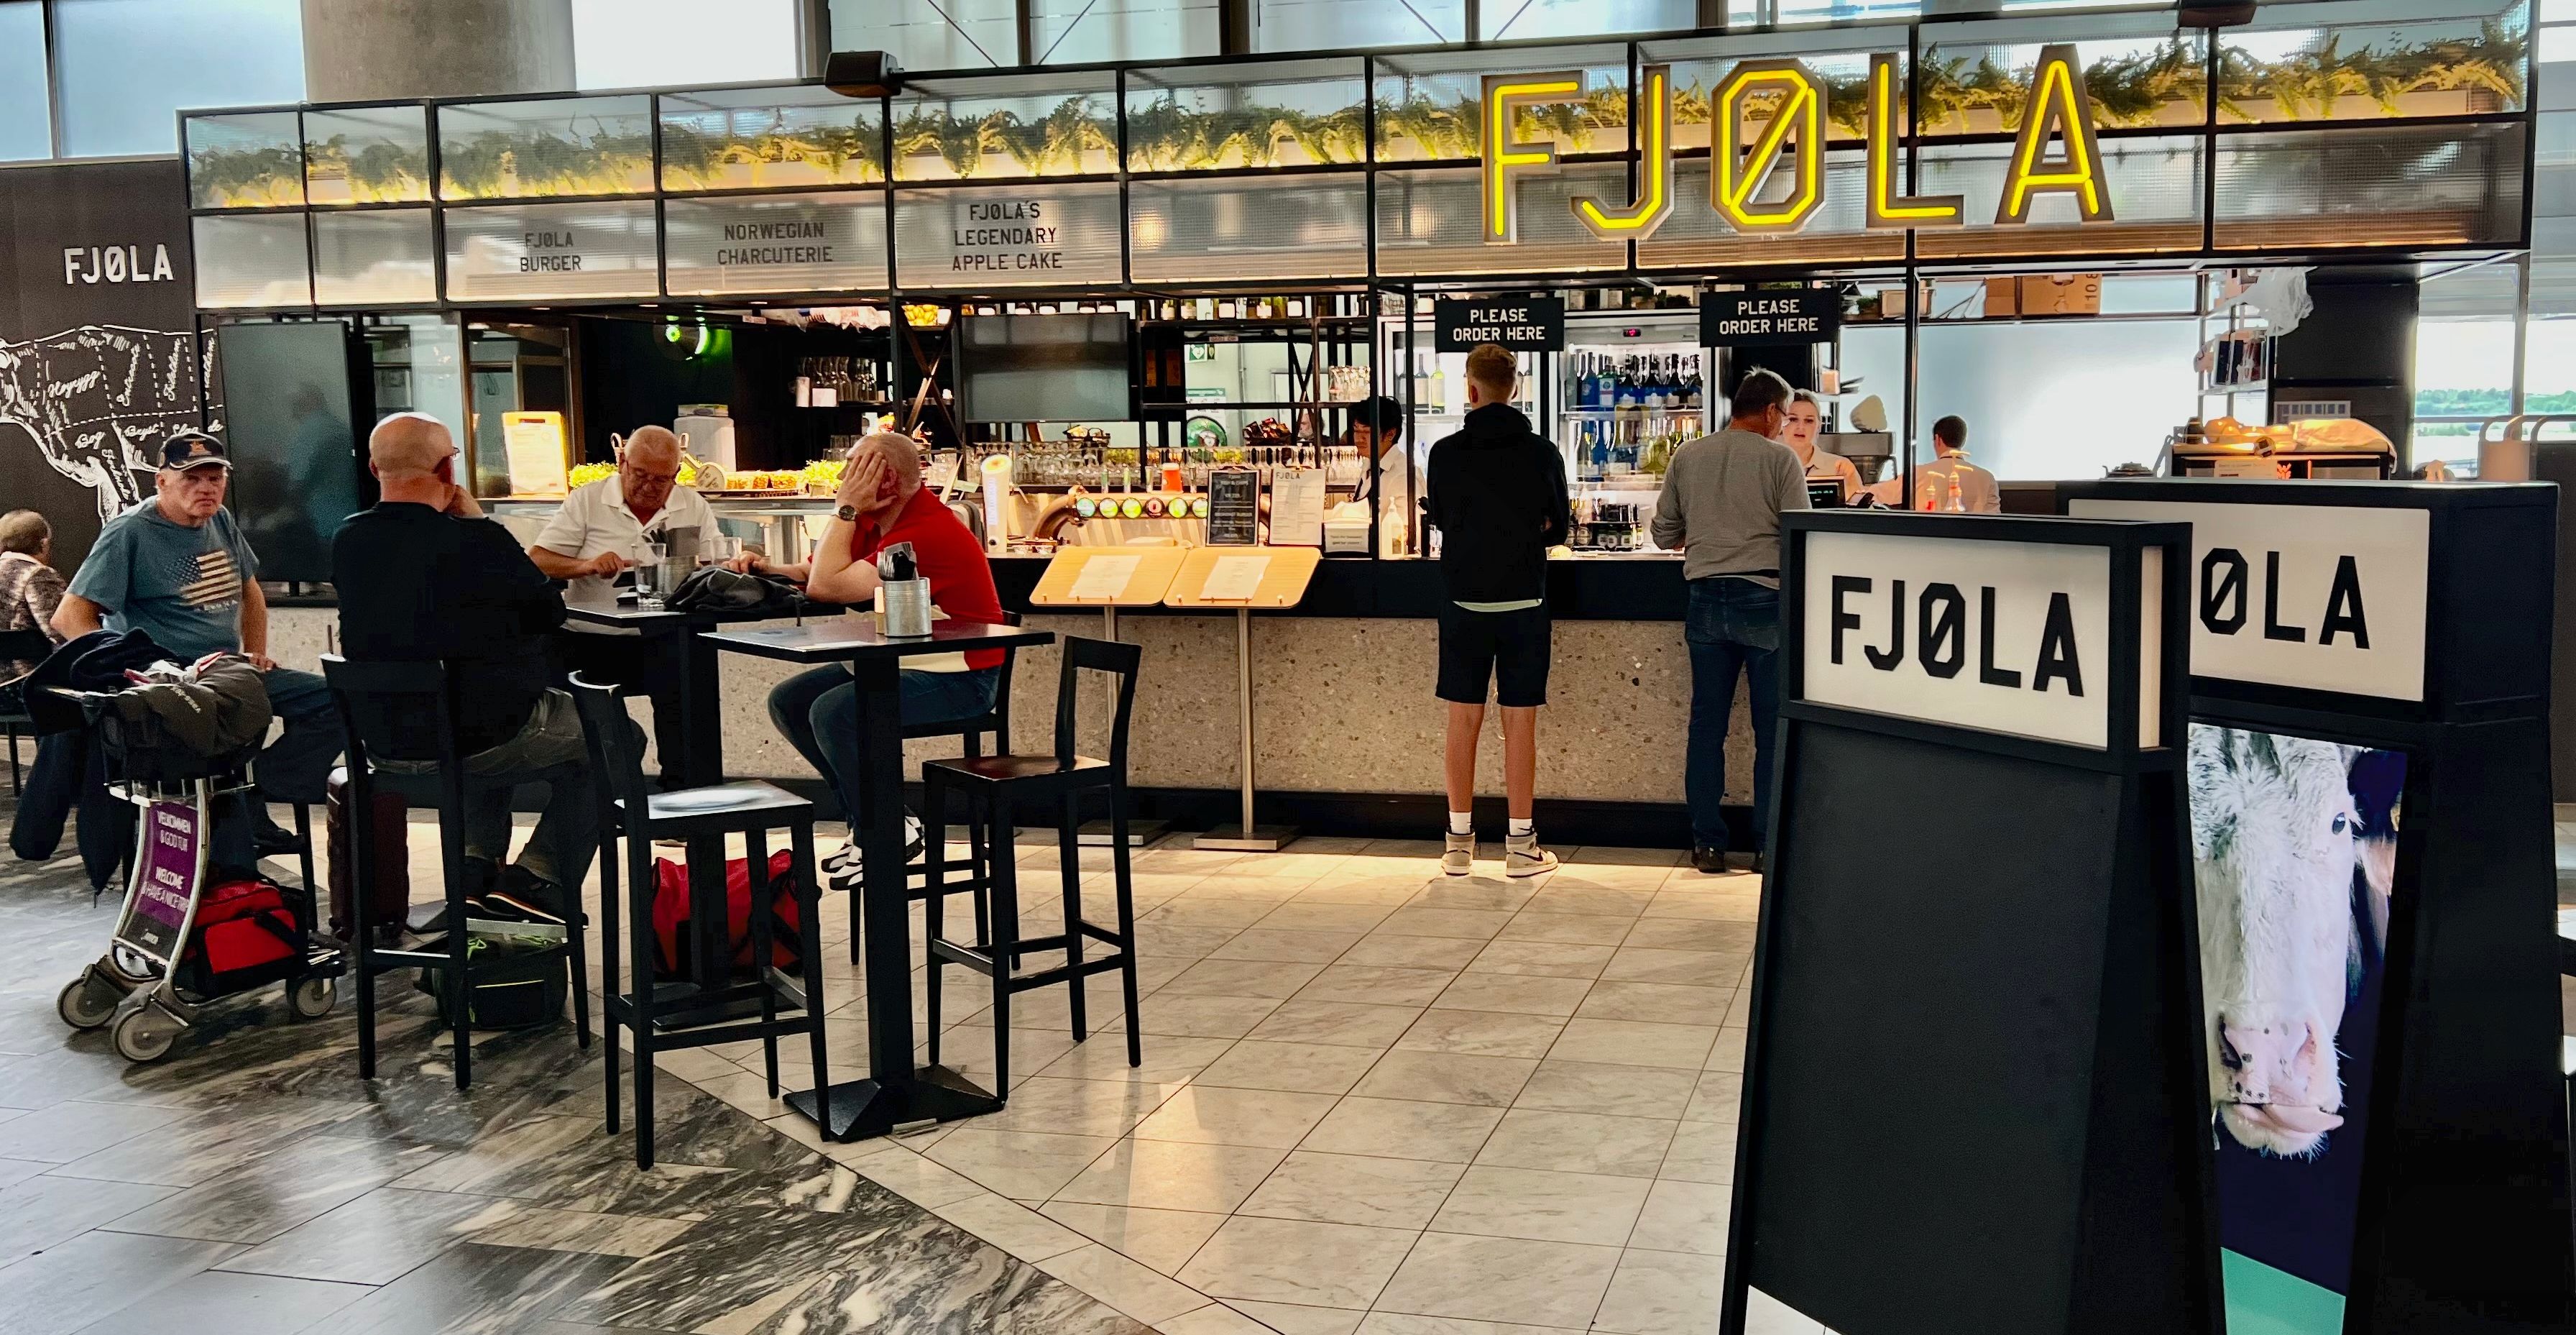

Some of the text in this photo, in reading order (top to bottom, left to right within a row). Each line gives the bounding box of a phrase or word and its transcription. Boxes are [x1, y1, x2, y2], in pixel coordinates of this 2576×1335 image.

[1482, 43, 2115, 246] FJØLA
[525, 231, 574, 248] FJØLA
[724, 222, 824, 241] NORWEGIAN
[954, 227, 1057, 246] LEGENDARY
[64, 244, 174, 285] FJØLA
[520, 255, 581, 272] BURGER
[717, 247, 833, 265] CHARCUTERIE
[952, 252, 1062, 271] APPLE CAKE
[1470, 308, 1528, 324] PLEASE
[1738, 298, 1800, 316] PLEASE
[1453, 326, 1545, 342] ORDER HERE
[1719, 317, 1818, 335] ORDER HERE
[75, 431, 106, 450] Bog
[2199, 547, 2370, 650] ØLA
[1831, 574, 2084, 698] FJØLA
